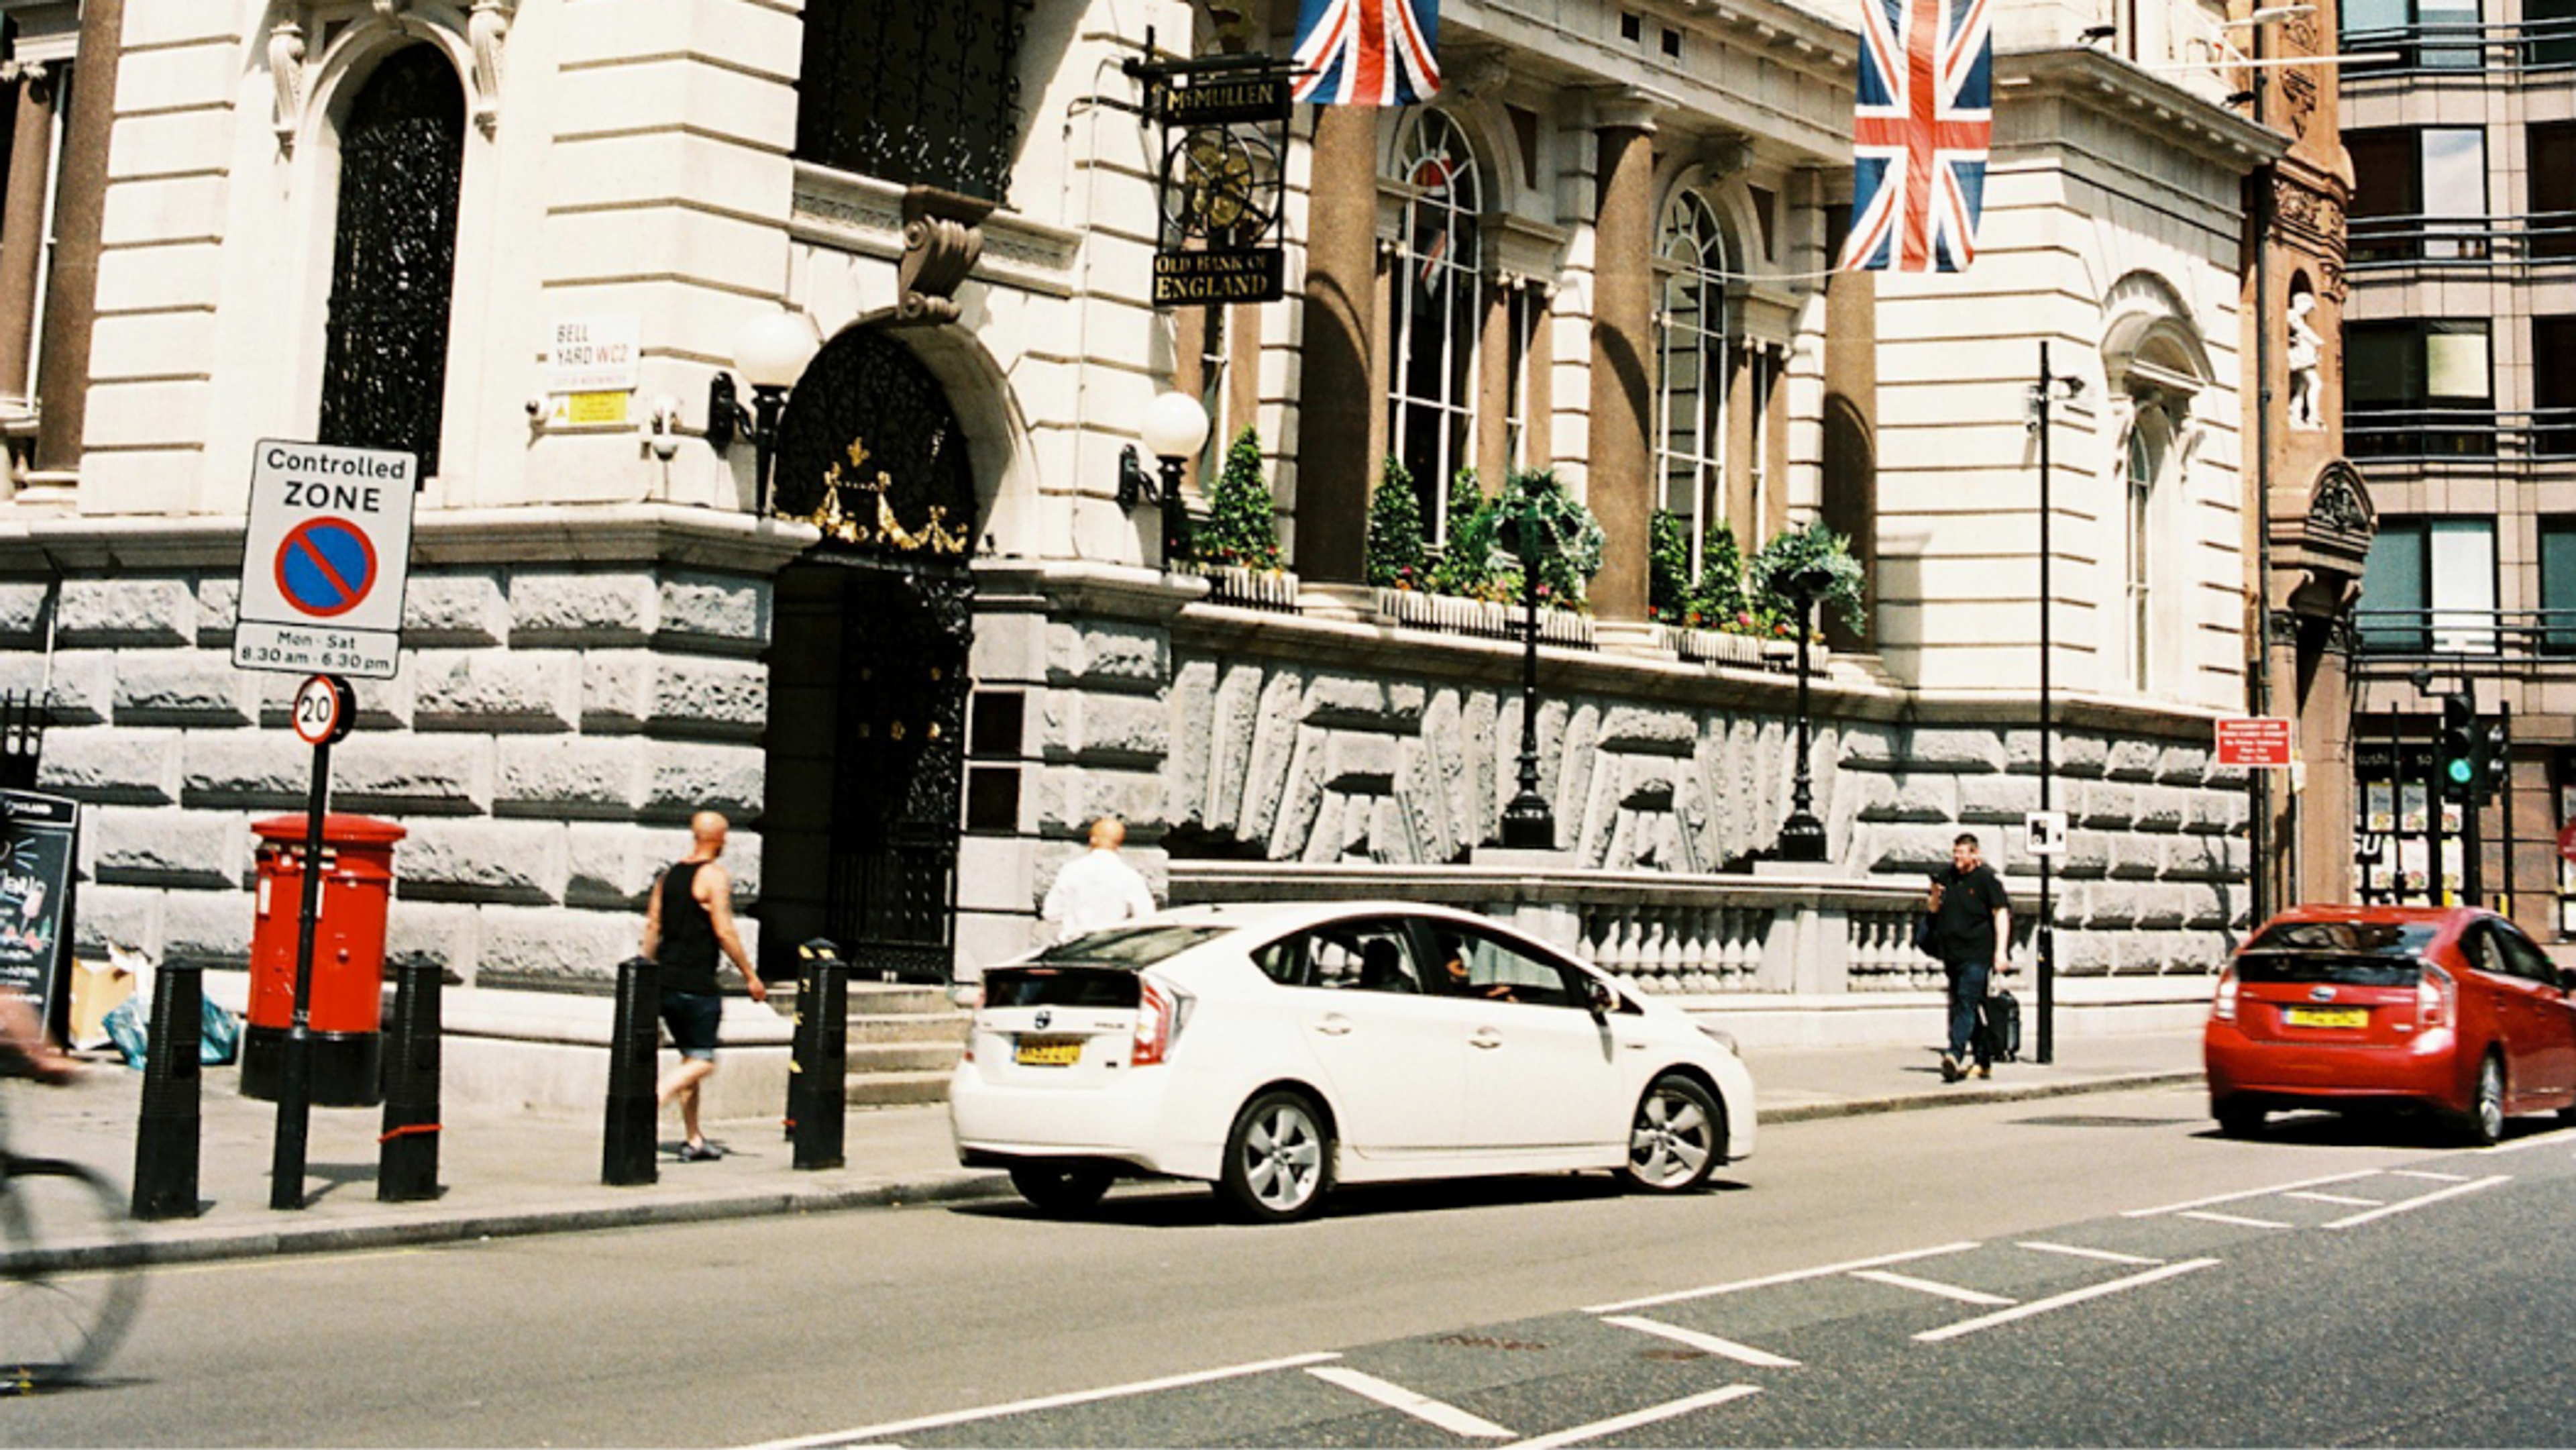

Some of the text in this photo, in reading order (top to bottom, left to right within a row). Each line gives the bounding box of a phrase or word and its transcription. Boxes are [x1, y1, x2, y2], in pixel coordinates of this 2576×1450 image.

[1155, 256, 1191, 273] OLD
[1196, 256, 1243, 271] BANK
[1156, 274, 1268, 299] ENGLAND
[557, 323, 588, 343] BELL
[557, 344, 629, 365] YARD WC2
[267, 448, 406, 479] Controlled
[284, 480, 381, 513] ZONE
[277, 630, 313, 646] Mon
[327, 635, 356, 650] Sat
[241, 645, 281, 662] 8.30
[284, 652, 309, 664] am
[321, 652, 361, 668] 6.30
[364, 658, 389, 670] pm
[300, 698, 331, 724] 20
